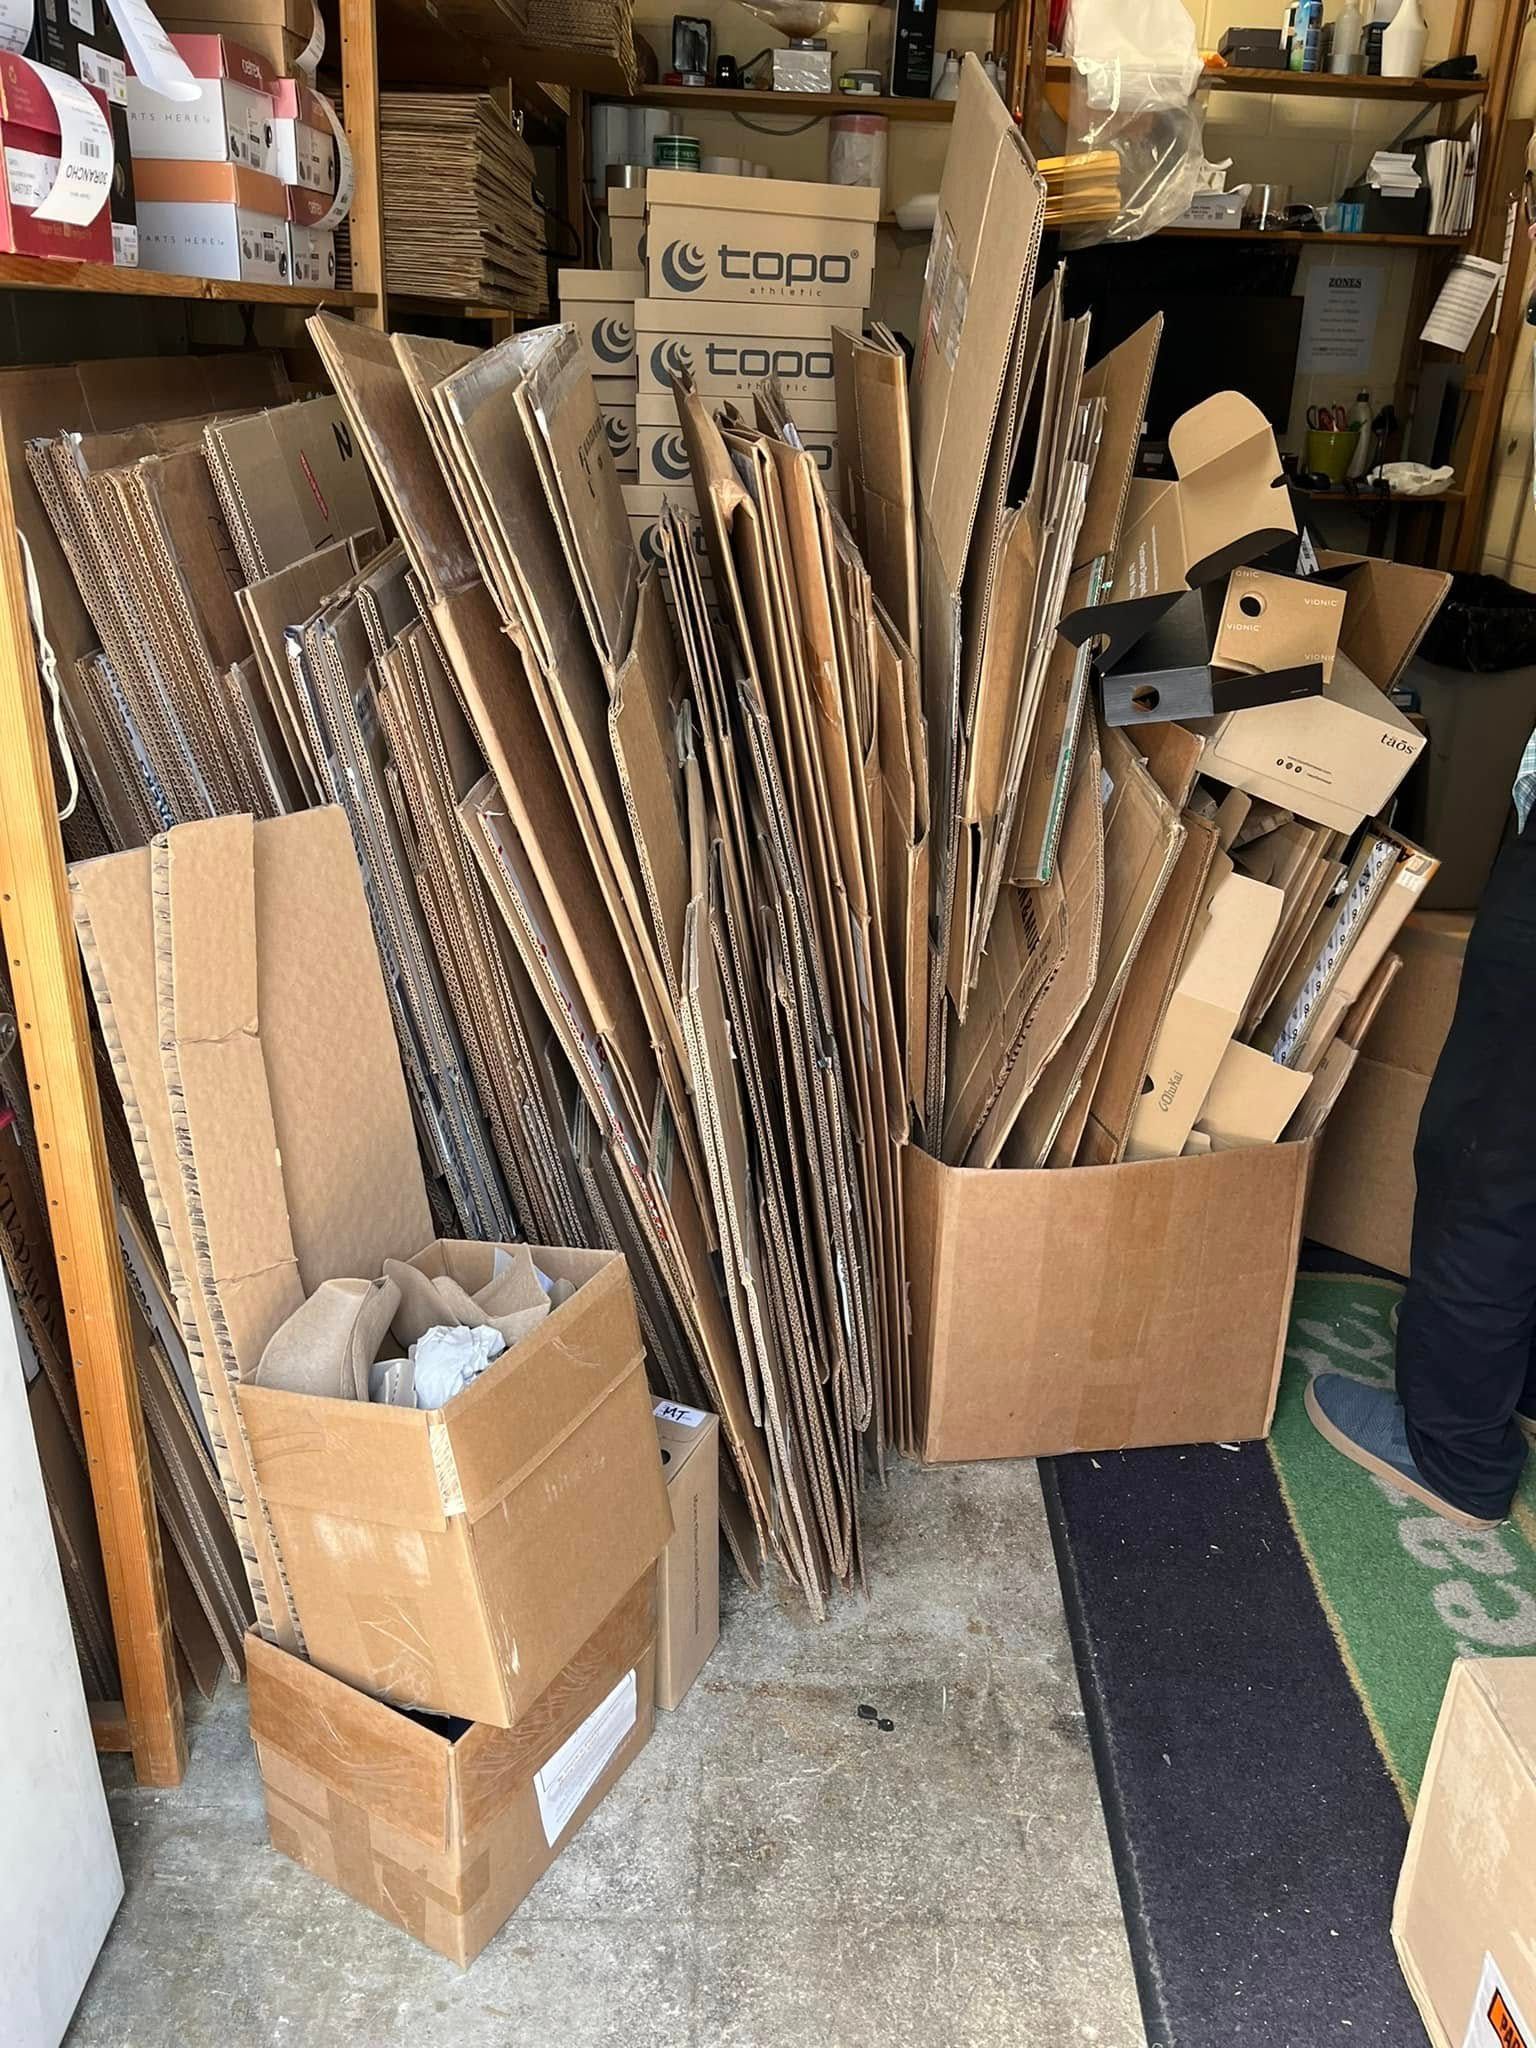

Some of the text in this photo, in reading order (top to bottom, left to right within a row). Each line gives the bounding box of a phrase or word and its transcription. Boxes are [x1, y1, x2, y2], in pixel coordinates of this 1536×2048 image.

[717, 244, 851, 287] topo
[1328, 277, 1362, 288] ZONES
[749, 286, 822, 298] athletic
[705, 342, 834, 380] topo
[1303, 597, 1337, 607] VIONIC
[1226, 623, 1260, 632] VIONIC
